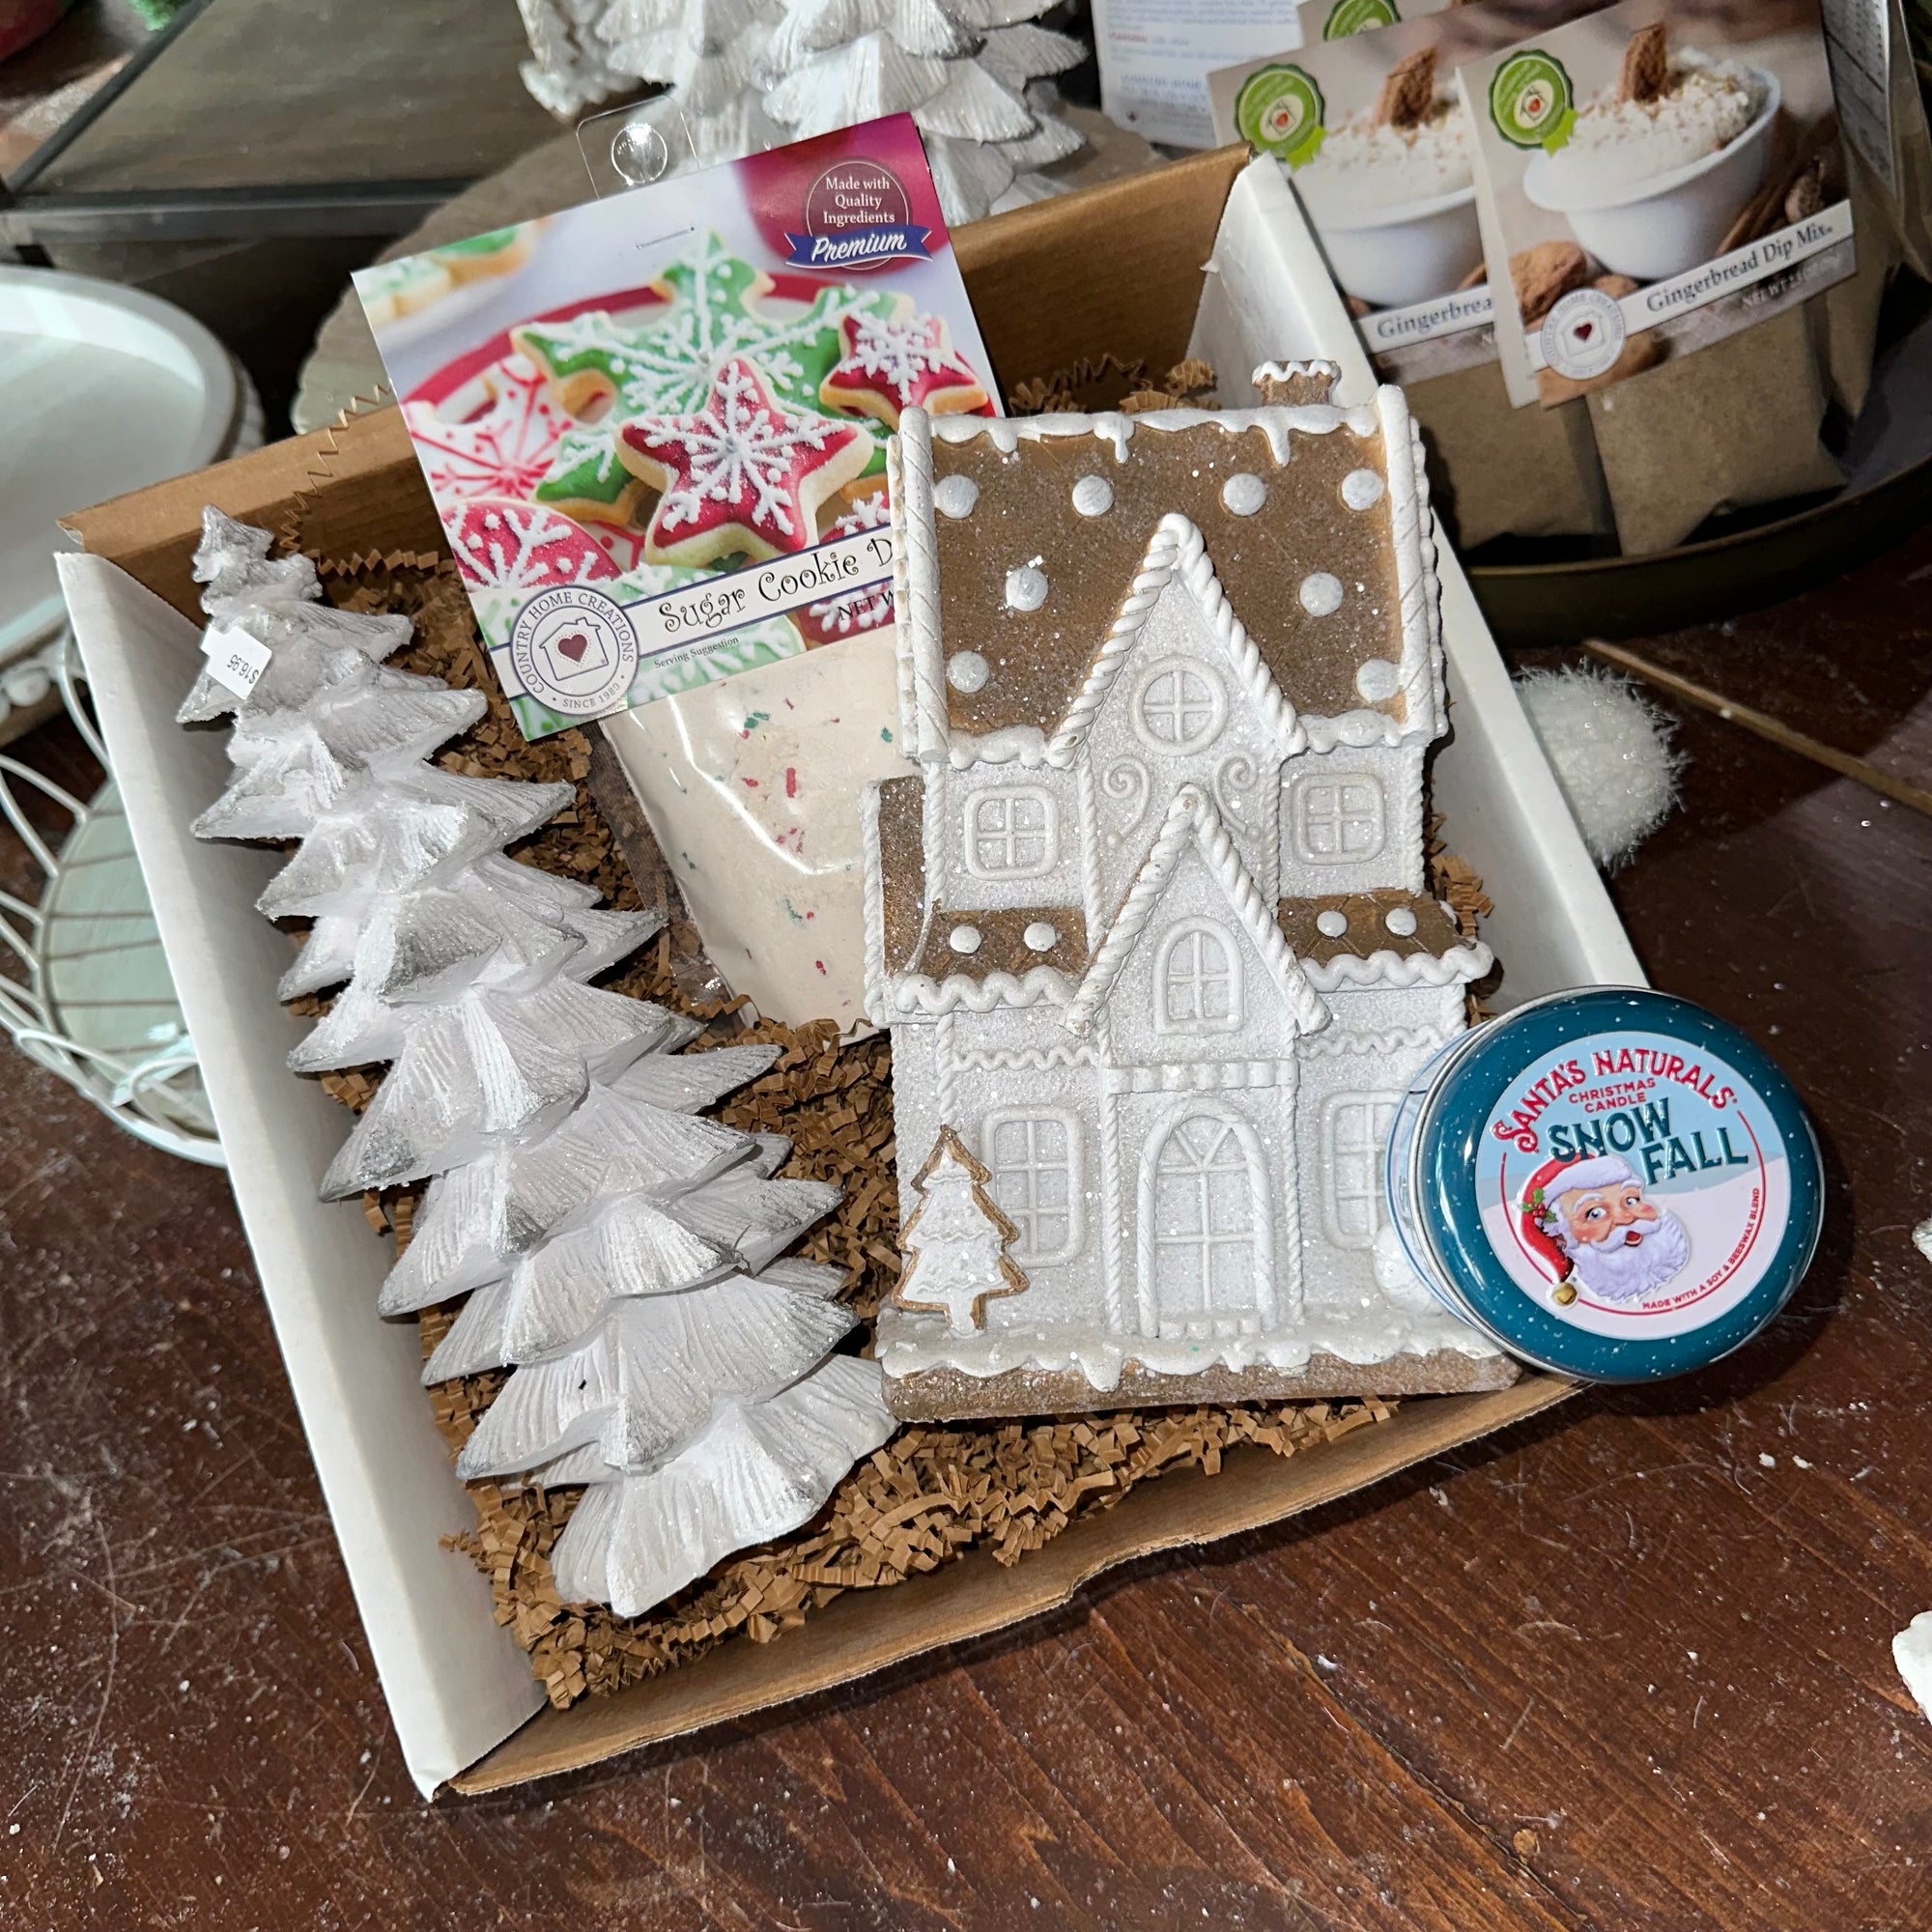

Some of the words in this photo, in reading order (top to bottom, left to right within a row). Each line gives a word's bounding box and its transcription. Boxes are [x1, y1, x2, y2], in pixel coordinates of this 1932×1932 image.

[826, 176, 861, 190] Made
[863, 176, 891, 190] with
[835, 193, 882, 210] Quality
[823, 211, 895, 227] Ingredients
[811, 232, 907, 262] Premium
[1646, 251, 1759, 313] Gingerbread
[1763, 239, 1792, 264] Dip
[1377, 298, 1493, 338] Gingerbrea
[528, 591, 573, 620] HOME
[659, 584, 746, 634] Sugar
[758, 552, 860, 604] Cookie
[837, 594, 875, 620] NET
[578, 593, 635, 663] CREATIONS
[516, 621, 545, 694] COUNTRY
[654, 652, 690, 668] Serving
[690, 637, 739, 656] Suggestion
[227, 654, 260, 685] $16.95
[562, 697, 597, 709] SINCE
[1492, 1060, 1586, 1153] SANTA'S
[1592, 1048, 1735, 1110] NATURALS
[1569, 1078, 1656, 1104] CHRISTMAS
[1584, 1092, 1647, 1114] CANDLE
[1547, 1096, 1671, 1163] SNOW
[1639, 1126, 1749, 1186] FALL
[1642, 1299, 1670, 1310] MADE
[1672, 1288, 1698, 1303] WITH
[1699, 1284, 1707, 1293] A
[1706, 1269, 1723, 1287] SOY
[1727, 1222, 1755, 1264] BEESWAX
[1749, 1188, 1760, 1220] BLEND
